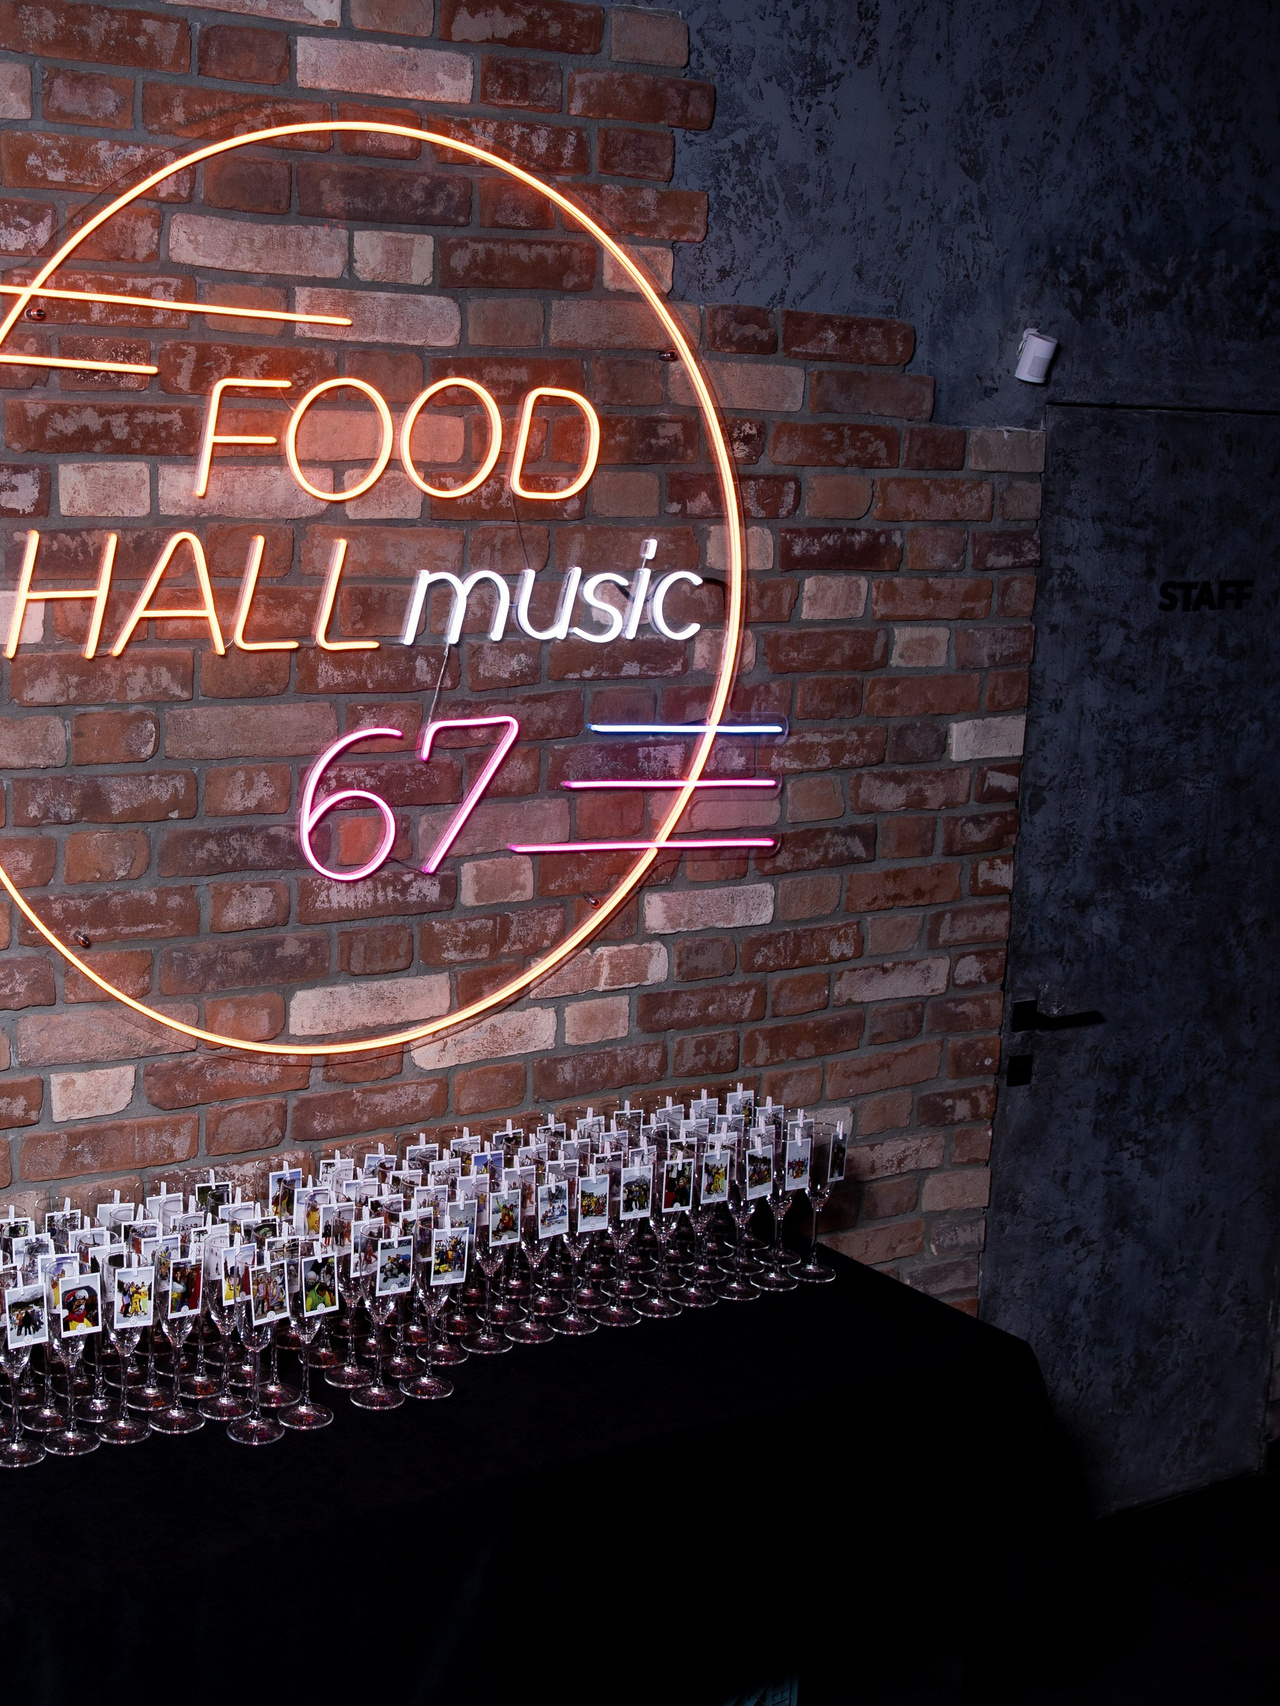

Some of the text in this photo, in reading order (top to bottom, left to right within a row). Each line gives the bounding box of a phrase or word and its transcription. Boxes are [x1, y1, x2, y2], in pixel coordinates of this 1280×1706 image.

[195, 377, 601, 501] FOOD
[4, 529, 704, 659] HALL music
[1158, 580, 1255, 612] STAFF
[298, 715, 521, 882] 67
